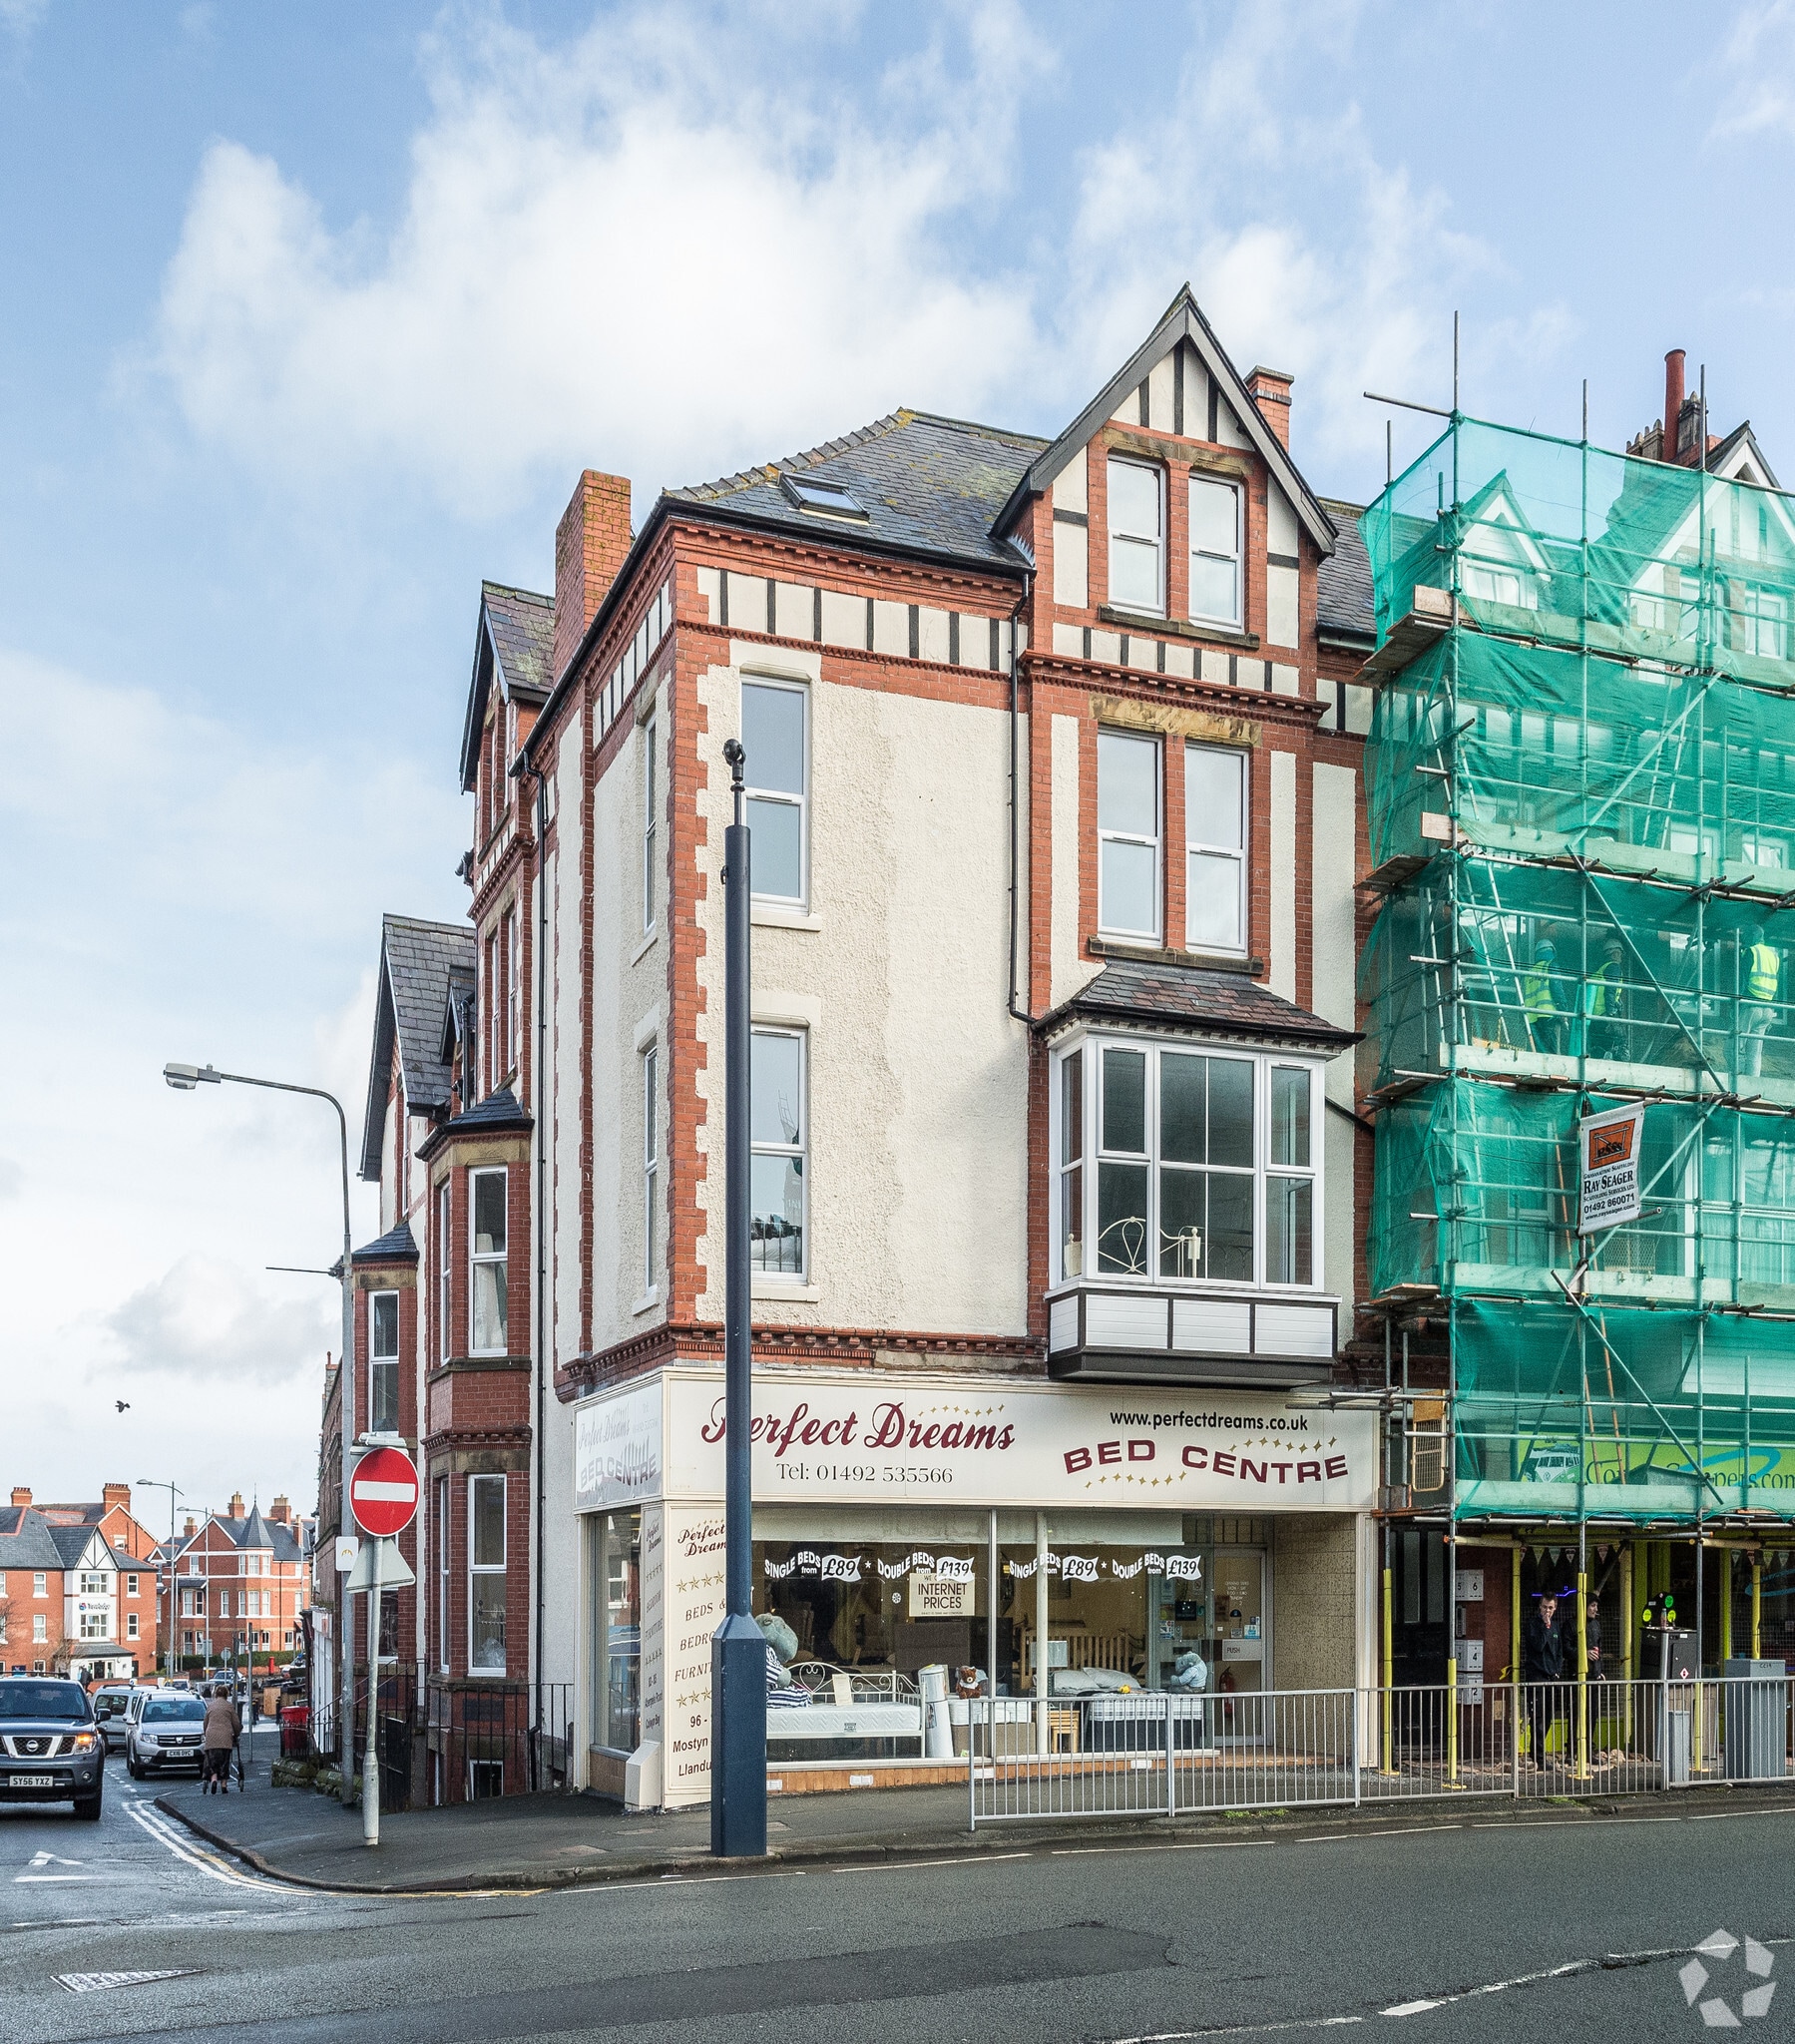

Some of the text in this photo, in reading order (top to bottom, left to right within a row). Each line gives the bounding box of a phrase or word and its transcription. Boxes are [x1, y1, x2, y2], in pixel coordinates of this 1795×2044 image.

[1583, 1170, 1633, 1195] RAY SEAGER
[1583, 1193, 1635, 1214] 01492 860071
[1585, 1204, 1635, 1221] www.rayseager.com
[863, 1401, 1016, 1450] Dreams
[1110, 1410, 1308, 1431] www.perfectdreams.co.uk
[581, 1453, 657, 1489] BED CENTRE
[1064, 1440, 1349, 1484] BED CENTRE
[776, 1463, 953, 1483] Tel: 01492 535566
[677, 1524, 725, 1544] Perfect
[764, 1557, 795, 1578] SINGLE
[797, 1551, 821, 1568] BEDS
[823, 1558, 856, 1576] £89
[878, 1556, 910, 1579] DOUBLE
[912, 1552, 935, 1568] BEDS
[939, 1561, 970, 1576] £139
[1009, 1558, 1038, 1579] SINGLE
[1039, 1553, 1061, 1568] BEDS
[1064, 1559, 1095, 1576] £89
[1113, 1557, 1142, 1579] DOUBLE
[1144, 1553, 1165, 1569] BEDS
[1168, 1560, 1196, 1575] £139
[918, 1583, 967, 1595] INTERNET
[1472, 1582, 1478, 1591] 6
[685, 1602, 713, 1621] BEDS
[923, 1597, 962, 1609] PRICES
[1472, 1652, 1478, 1661] 4
[689, 1715, 701, 1728] 96
[673, 1738, 708, 1753] Mostyn
